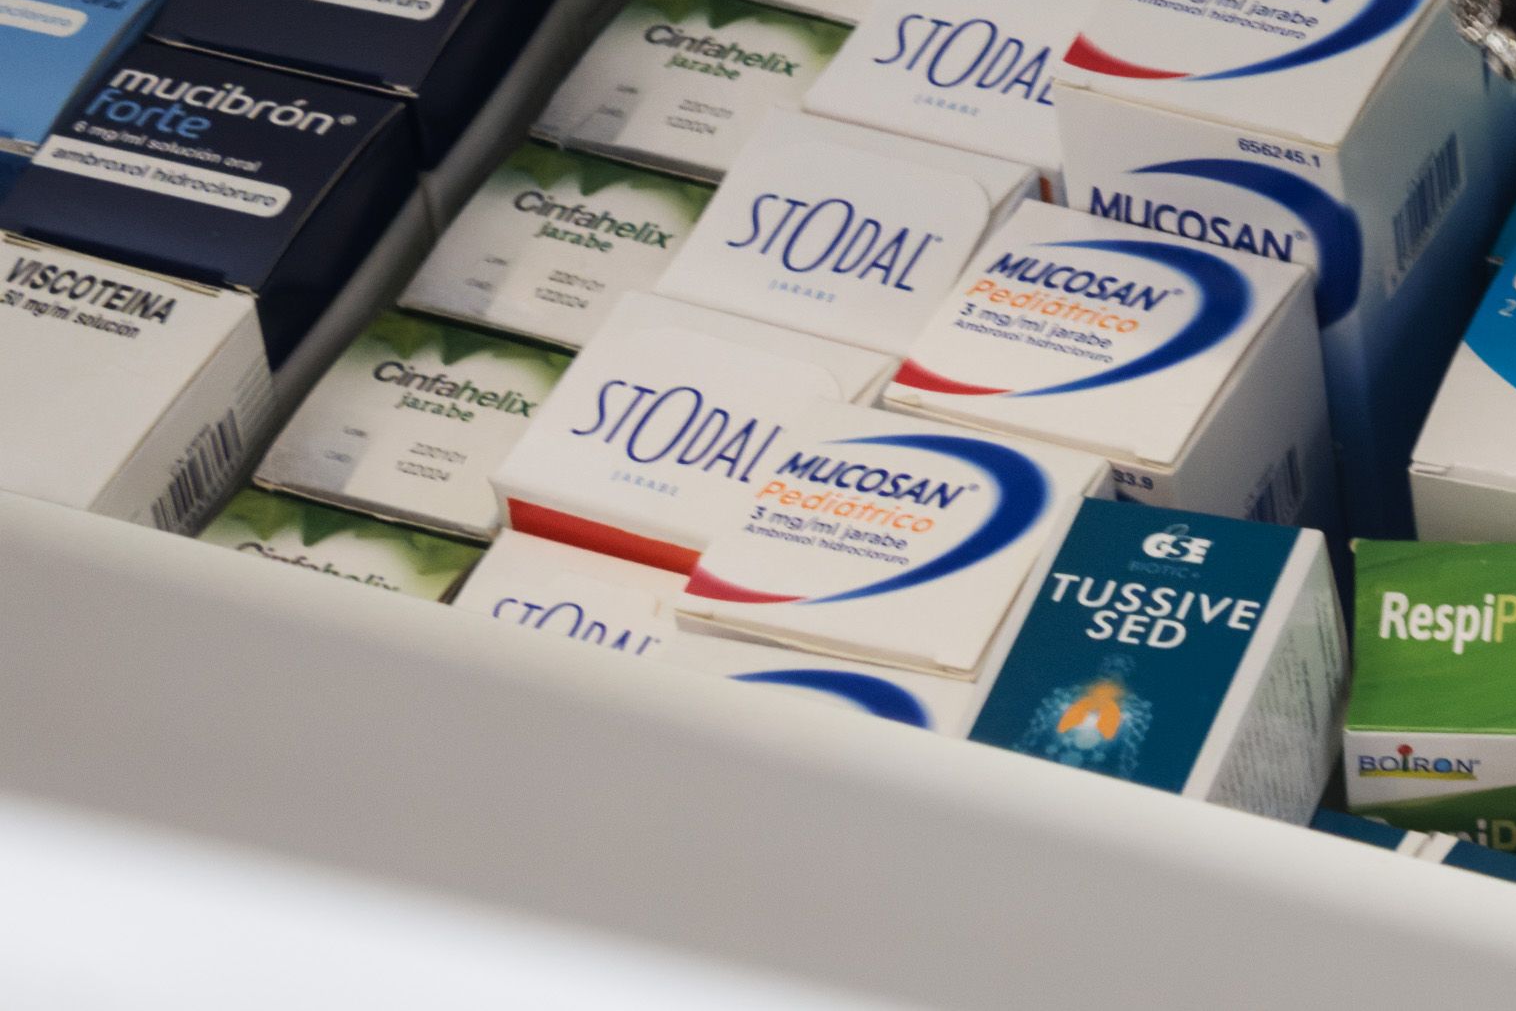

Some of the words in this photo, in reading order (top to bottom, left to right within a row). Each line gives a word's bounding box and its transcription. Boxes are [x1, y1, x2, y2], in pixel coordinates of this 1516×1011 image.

[644, 24, 800, 78] Cinfahelix
[85, 88, 212, 140] forte
[109, 68, 333, 136] mucibrón
[88, 123, 145, 150] mg/ml
[147, 135, 221, 162] solución
[223, 153, 261, 172] oral
[51, 145, 151, 178] ambroxol
[153, 164, 278, 208] hidrocloruro
[514, 190, 676, 250] Cinfahelix
[535, 221, 614, 253] jarabe
[727, 194, 934, 293] STODAL
[1090, 186, 1293, 263] MUCOSAN
[6, 257, 178, 325] VISCOTEINA
[966, 279, 1140, 335] Pediátrico
[985, 252, 1172, 313] MUCOSAN
[980, 308, 1049, 335] mg/ml
[1050, 323, 1114, 350] jarabe
[373, 361, 539, 419] Cinfahelix
[396, 391, 477, 424] jarabe
[755, 480, 935, 535] Pediátrico
[776, 452, 968, 511] MUCOSAN
[750, 505, 766, 522] 3
[769, 509, 840, 536] mg/ml
[842, 523, 908, 552] jarabe
[1050, 572, 1261, 632] TUSSIVE
[1085, 608, 1188, 651] SED
[1357, 744, 1476, 775] BOIRON
